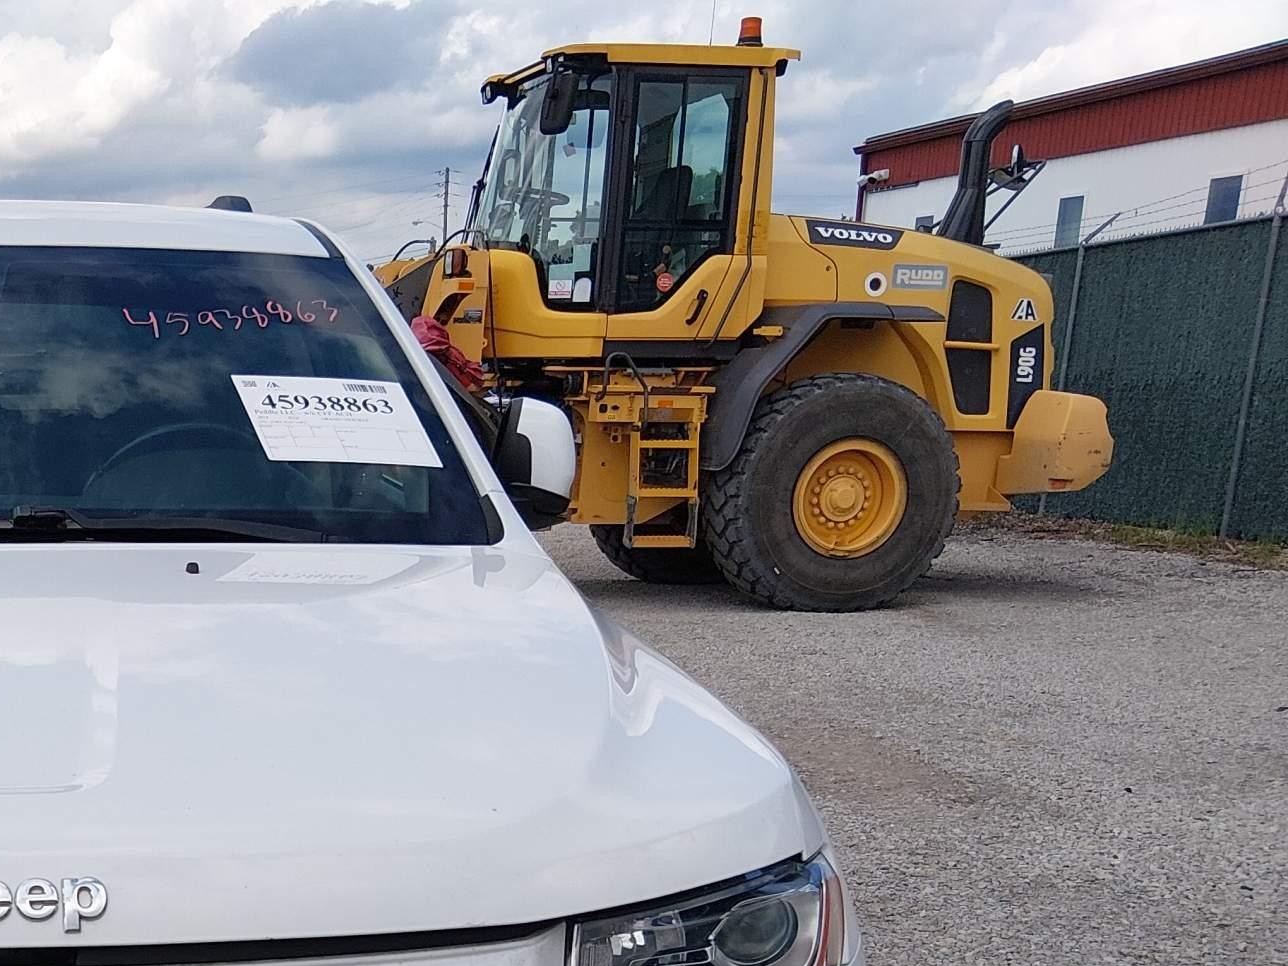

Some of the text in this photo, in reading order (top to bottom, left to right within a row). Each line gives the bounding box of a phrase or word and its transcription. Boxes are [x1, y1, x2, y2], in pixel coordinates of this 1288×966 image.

[814, 226, 893, 243] VOLVO
[895, 268, 945, 286] RUDD
[122, 300, 339, 339] 45938863
[1015, 346, 1037, 384] L90G
[260, 394, 395, 415] 45938863
